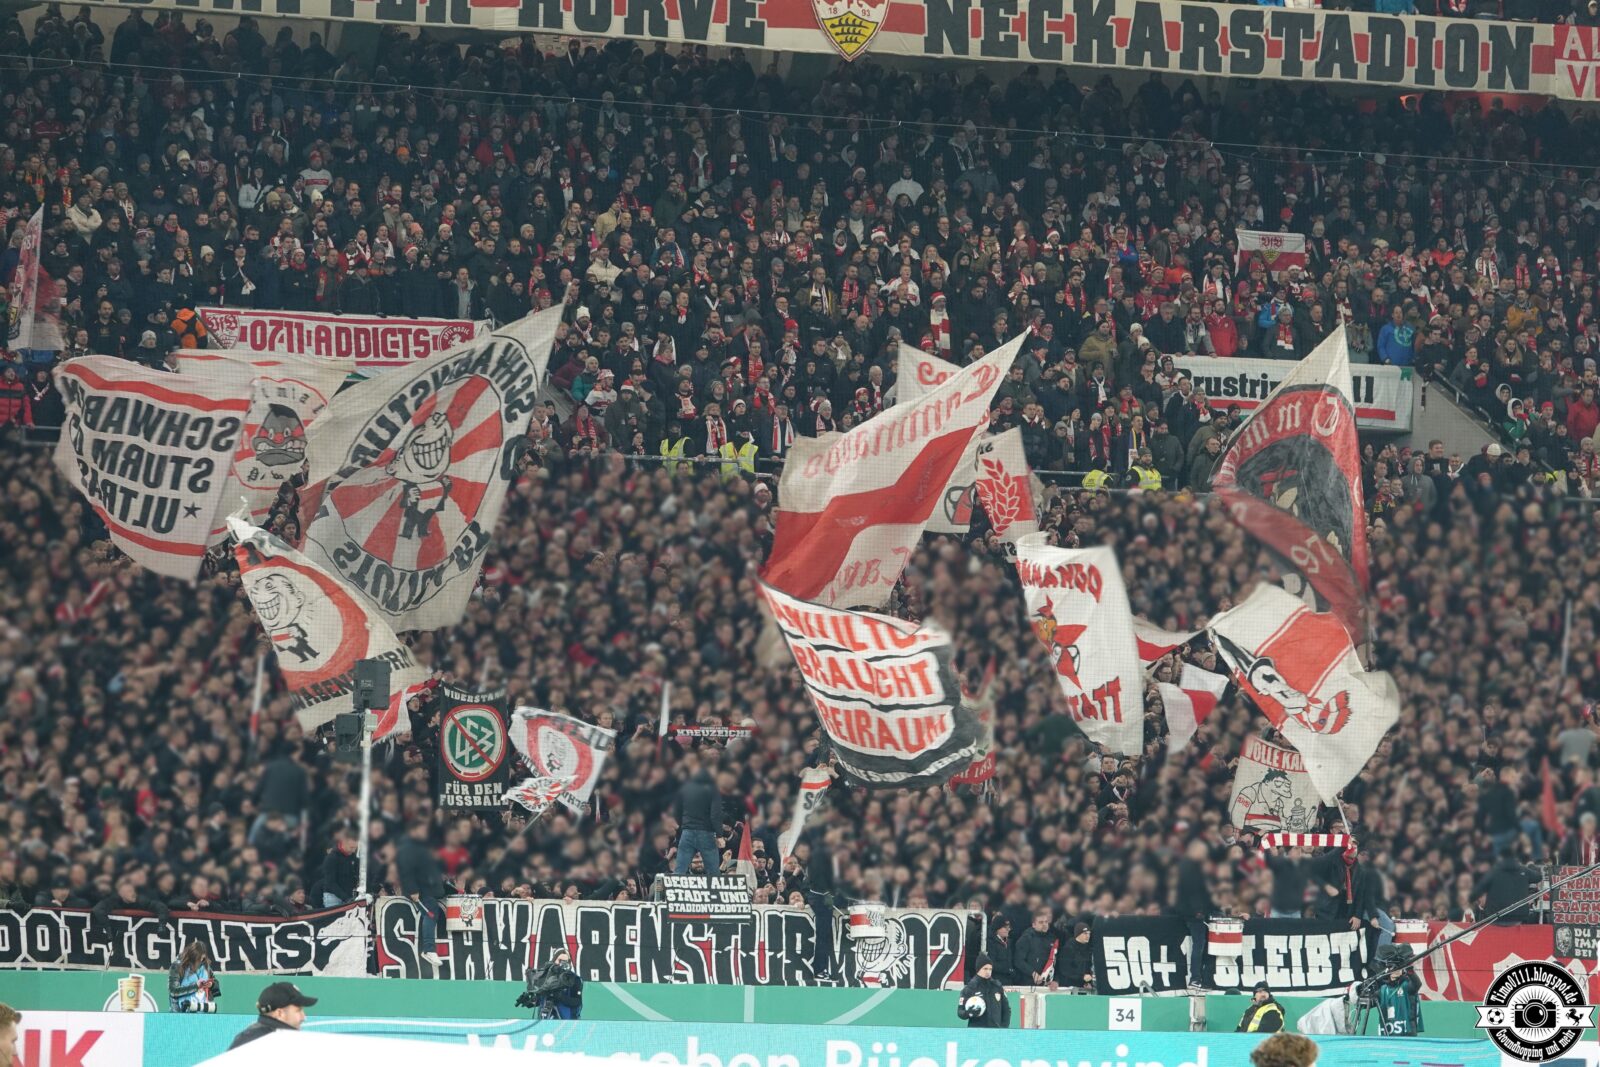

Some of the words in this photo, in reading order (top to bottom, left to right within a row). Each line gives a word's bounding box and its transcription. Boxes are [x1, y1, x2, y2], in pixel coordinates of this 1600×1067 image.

[923, 0, 1535, 90] NECKARSTADION
[314, 325, 431, 358] ADDICTS
[792, 643, 936, 698] BRAUCHT
[445, 781, 471, 796] FÜR
[474, 783, 502, 795] DEN
[711, 877, 746, 889] ALLE
[666, 889, 717, 902] STADT-
[719, 891, 749, 903] UND
[1115, 1008, 1135, 1022] 34
